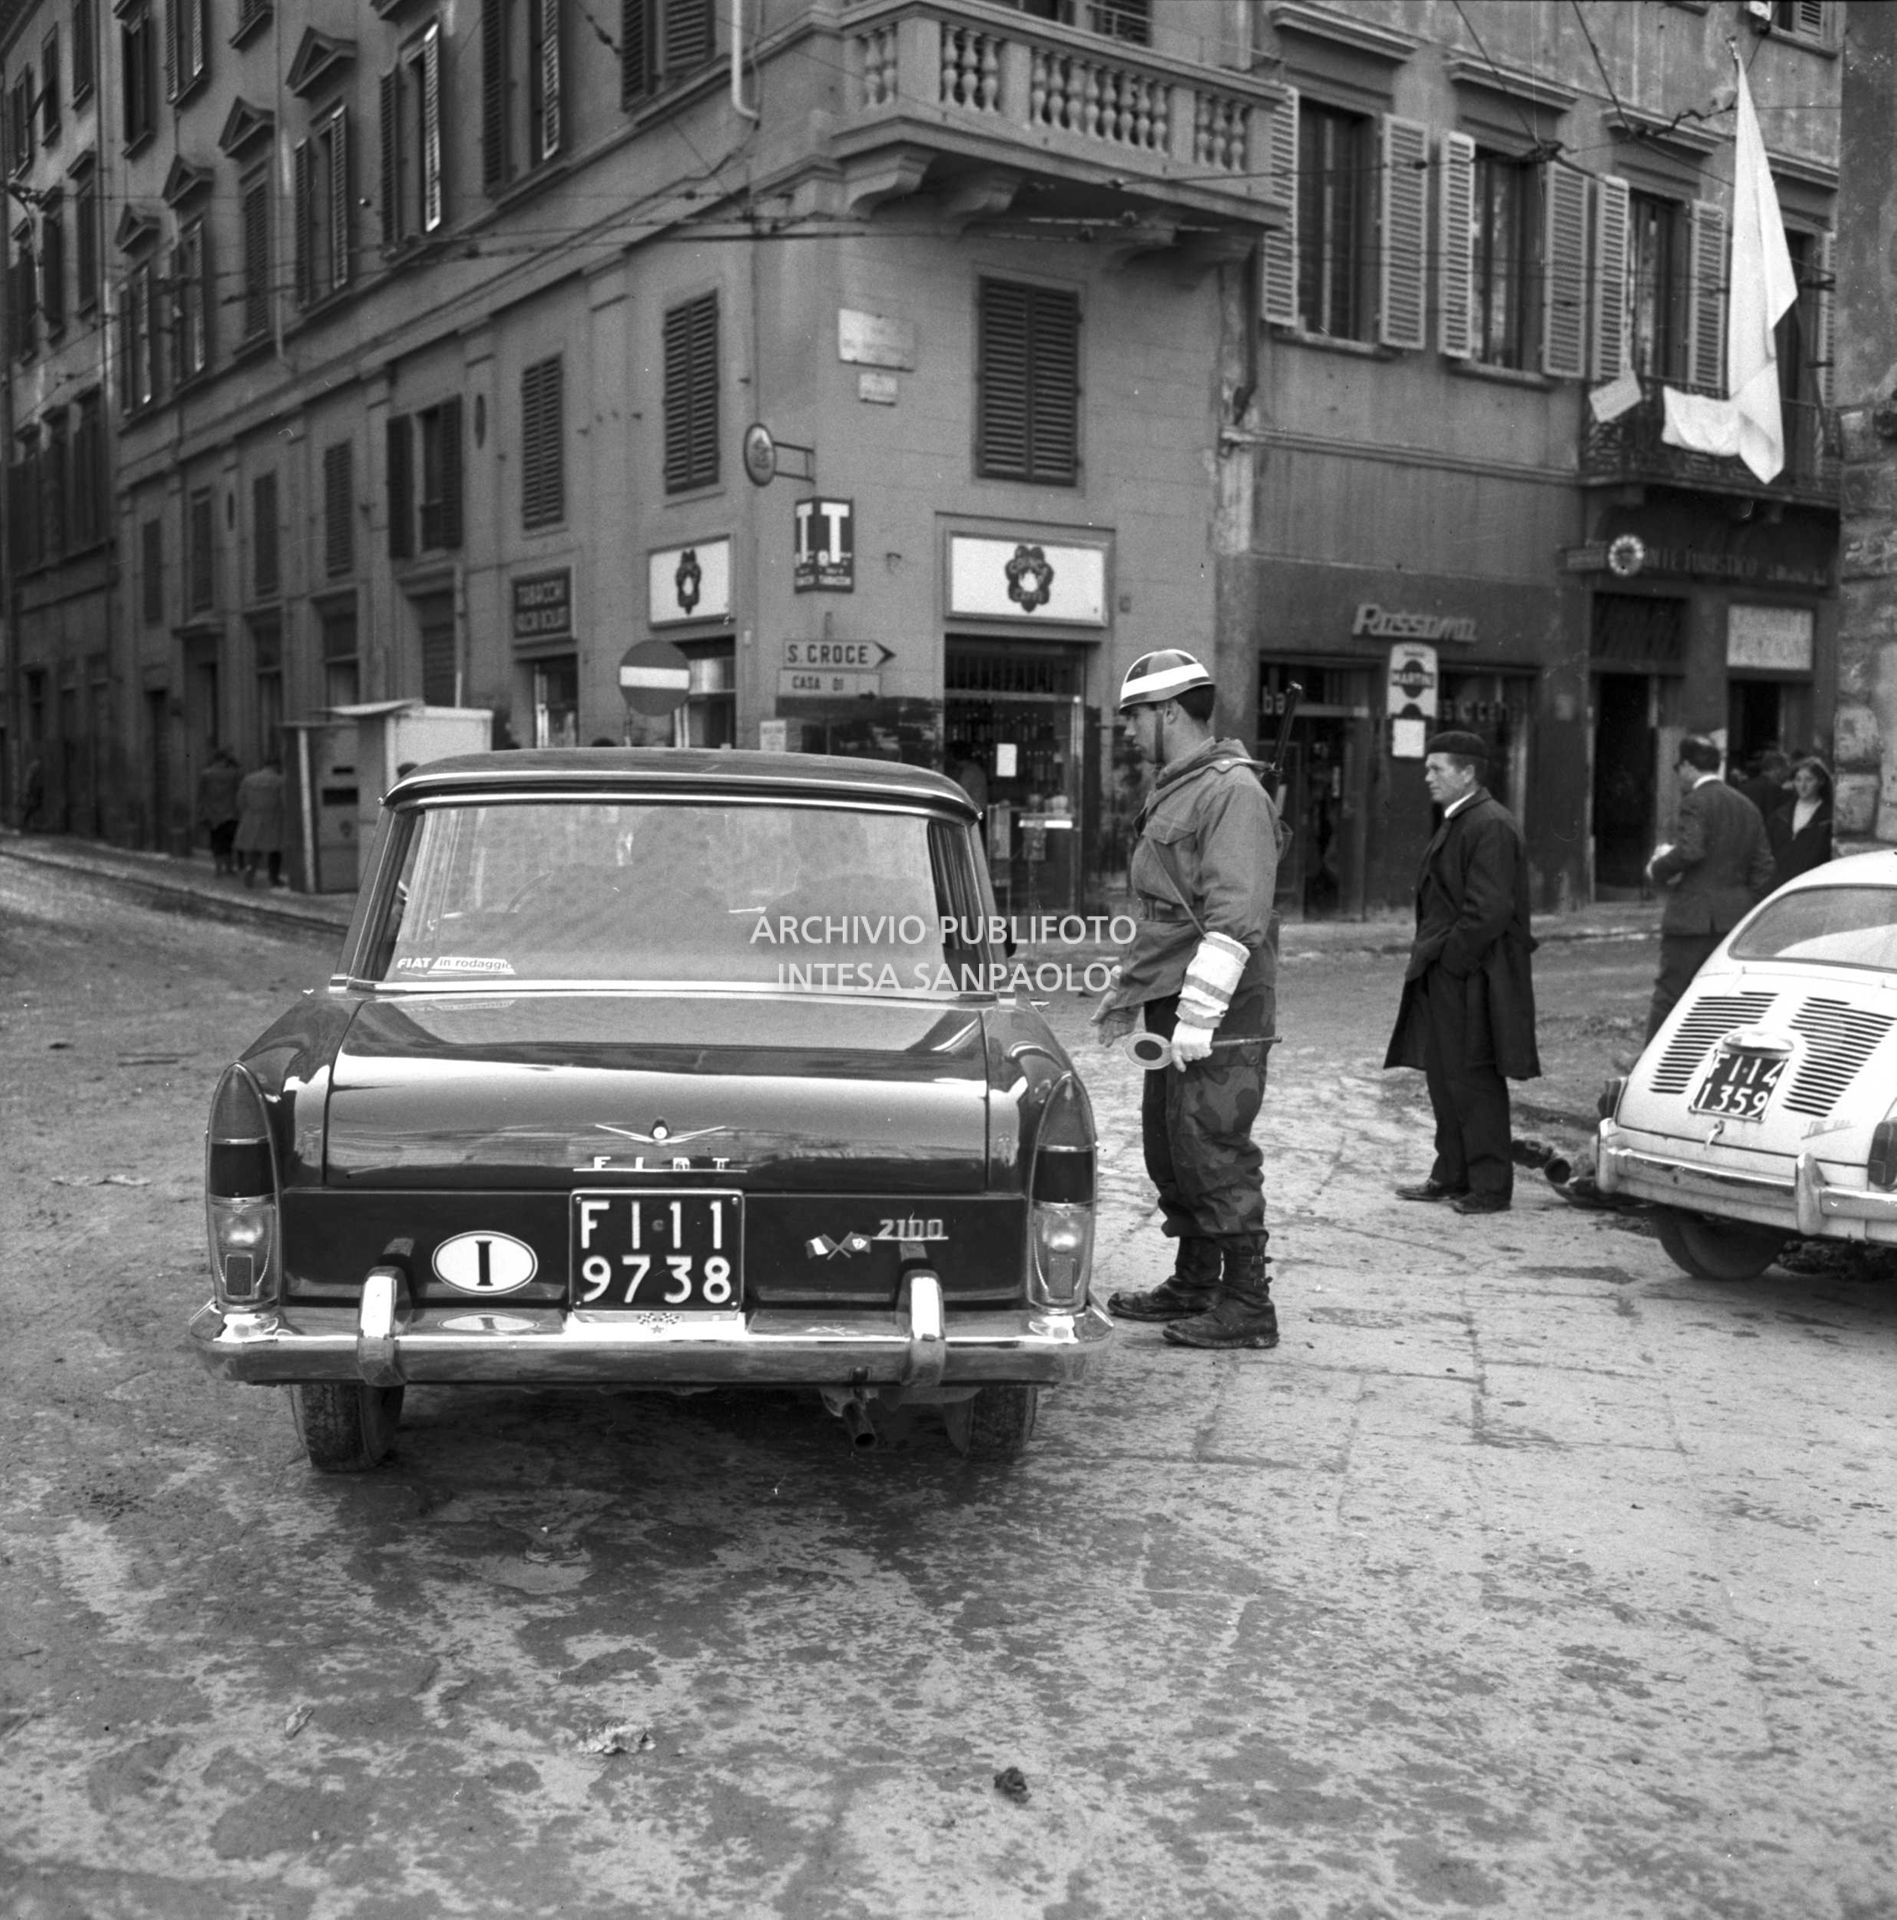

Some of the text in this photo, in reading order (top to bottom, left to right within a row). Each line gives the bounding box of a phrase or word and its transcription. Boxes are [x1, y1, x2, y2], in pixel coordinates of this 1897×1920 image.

[820, 502, 849, 564] T
[807, 644, 869, 664] CROCE
[792, 676, 821, 690] CASA
[396, 957, 513, 970] FIAT in rodaggio
[1697, 1083, 1769, 1117] 1359
[593, 1156, 730, 1170] FIAT
[877, 1218, 944, 1238] 2100
[475, 1240, 494, 1287] I
[581, 1255, 732, 1304] 9738
